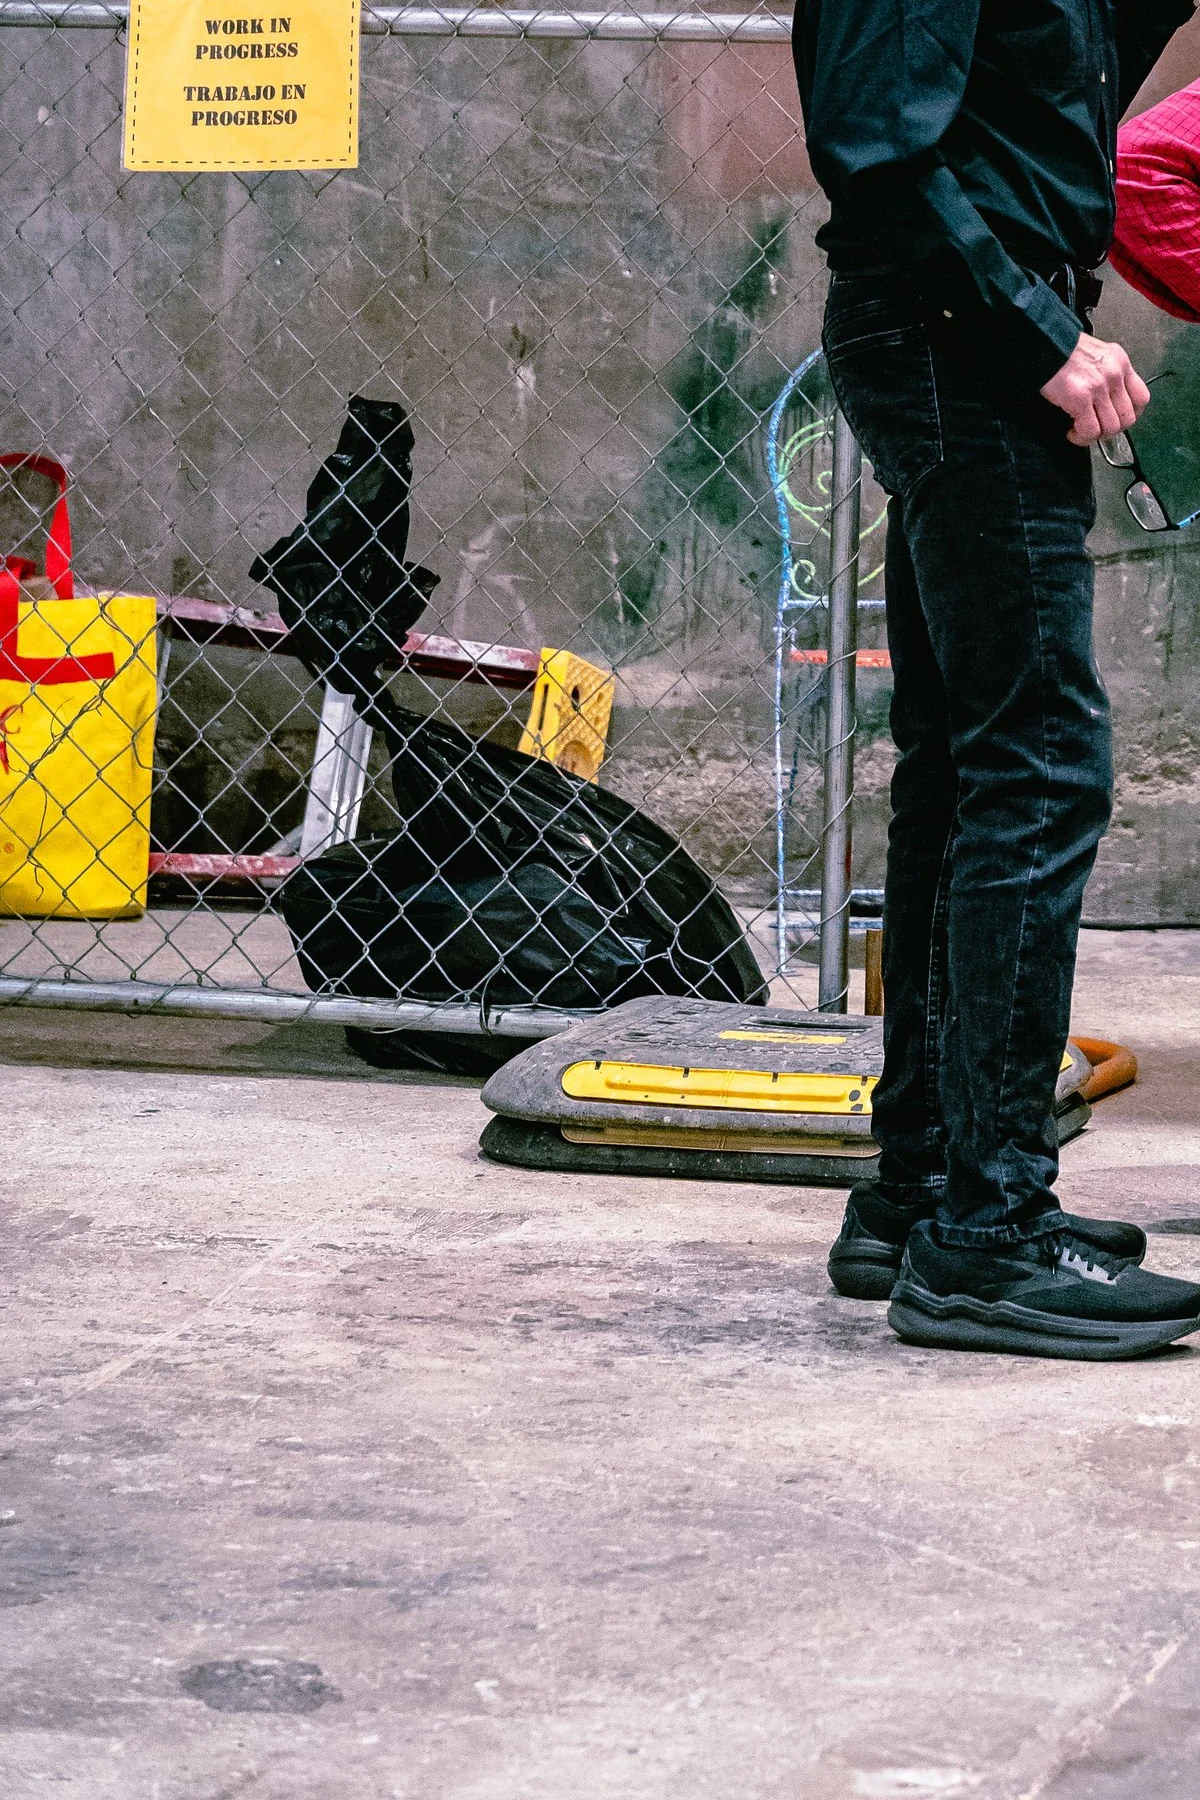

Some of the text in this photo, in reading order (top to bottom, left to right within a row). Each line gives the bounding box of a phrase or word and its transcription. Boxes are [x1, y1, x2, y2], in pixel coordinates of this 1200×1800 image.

[205, 17, 292, 35] WORK IN
[195, 42, 299, 60] PROGRESS
[183, 84, 307, 102] TRABAJO EN
[190, 109, 298, 127] PROGRESO
